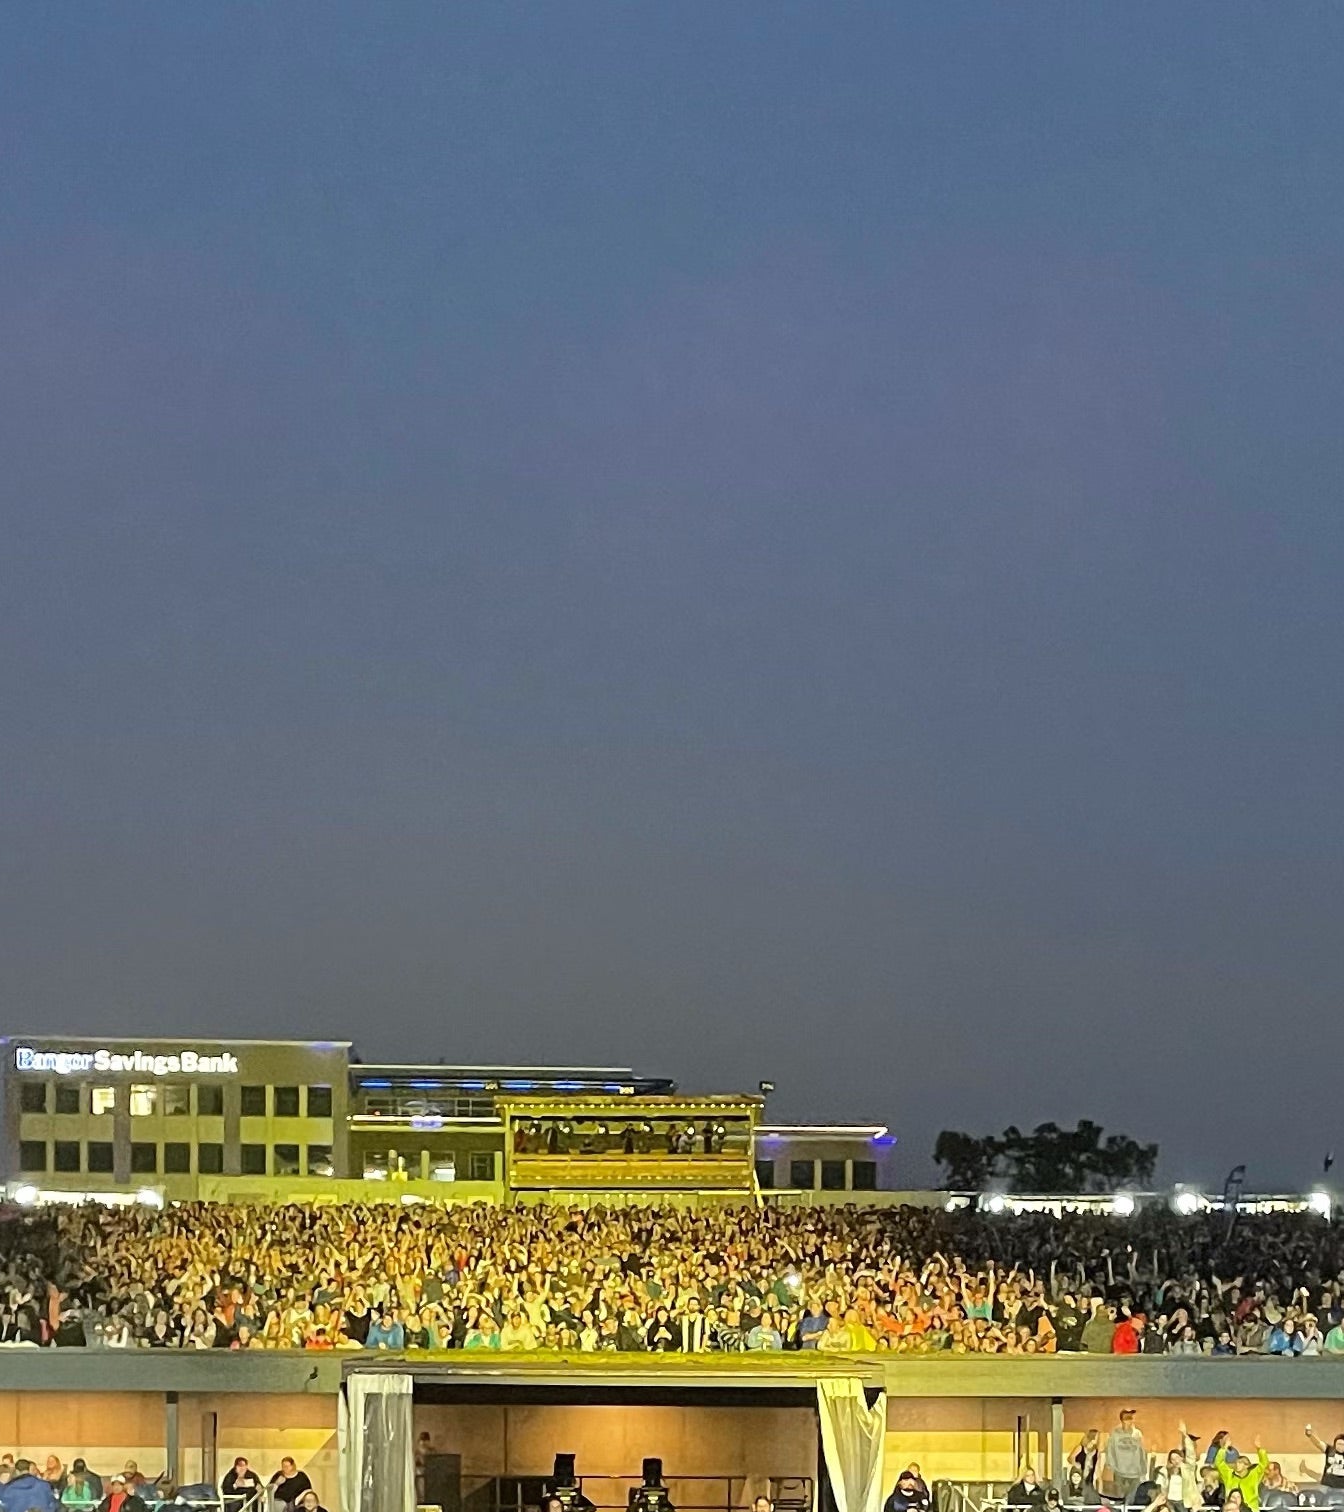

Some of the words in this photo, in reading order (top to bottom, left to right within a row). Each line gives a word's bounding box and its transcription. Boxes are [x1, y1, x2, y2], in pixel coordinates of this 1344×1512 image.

[16, 1047, 93, 1074] Bangor
[94, 1049, 180, 1075] Savings
[181, 1051, 238, 1073] Bank
